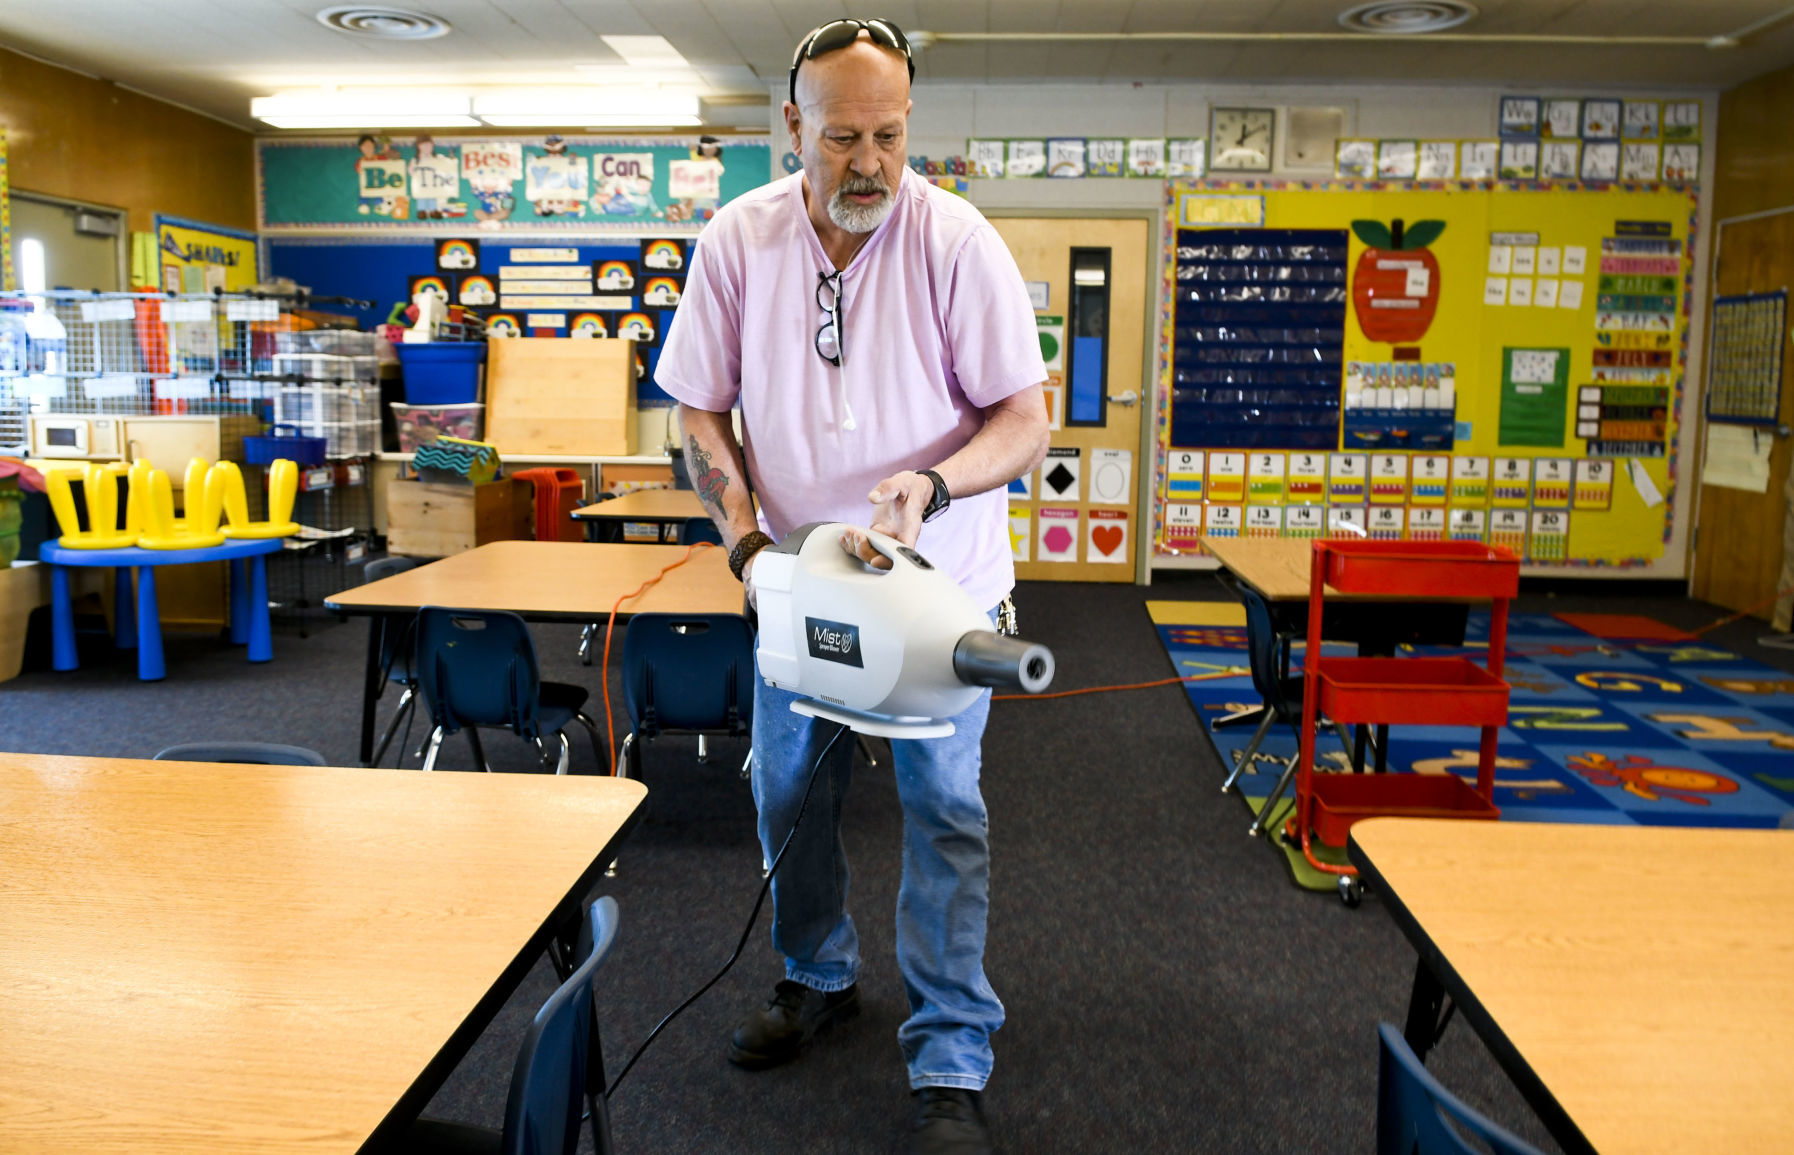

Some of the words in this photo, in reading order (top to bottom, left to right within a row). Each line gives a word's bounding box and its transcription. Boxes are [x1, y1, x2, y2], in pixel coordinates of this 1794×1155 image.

[363, 167, 403, 189] Be
[413, 166, 454, 187] The
[531, 166, 585, 190] You
[601, 156, 641, 177] Can
[1181, 454, 1191, 464] 0
[1225, 455, 1229, 465] 1
[1263, 456, 1271, 466] 2
[1304, 456, 1312, 466] 3
[1344, 457, 1352, 467] 4
[1386, 457, 1393, 467] 5
[1426, 458, 1434, 468] 6
[1468, 459, 1475, 469] 7
[1508, 460, 1516, 471] 8
[1550, 461, 1557, 472] 9
[1588, 463, 1602, 474] 10
[1179, 507, 1188, 516] 11
[1217, 508, 1229, 518] 12
[1257, 508, 1270, 519] 13
[1298, 509, 1310, 519] 14
[1340, 510, 1352, 521] 15
[1379, 509, 1392, 520] 16
[1420, 510, 1432, 520] 17
[1462, 512, 1473, 522] 18
[1503, 512, 1515, 523] 19
[1541, 513, 1558, 525] 20
[814, 626, 841, 646] Mist
